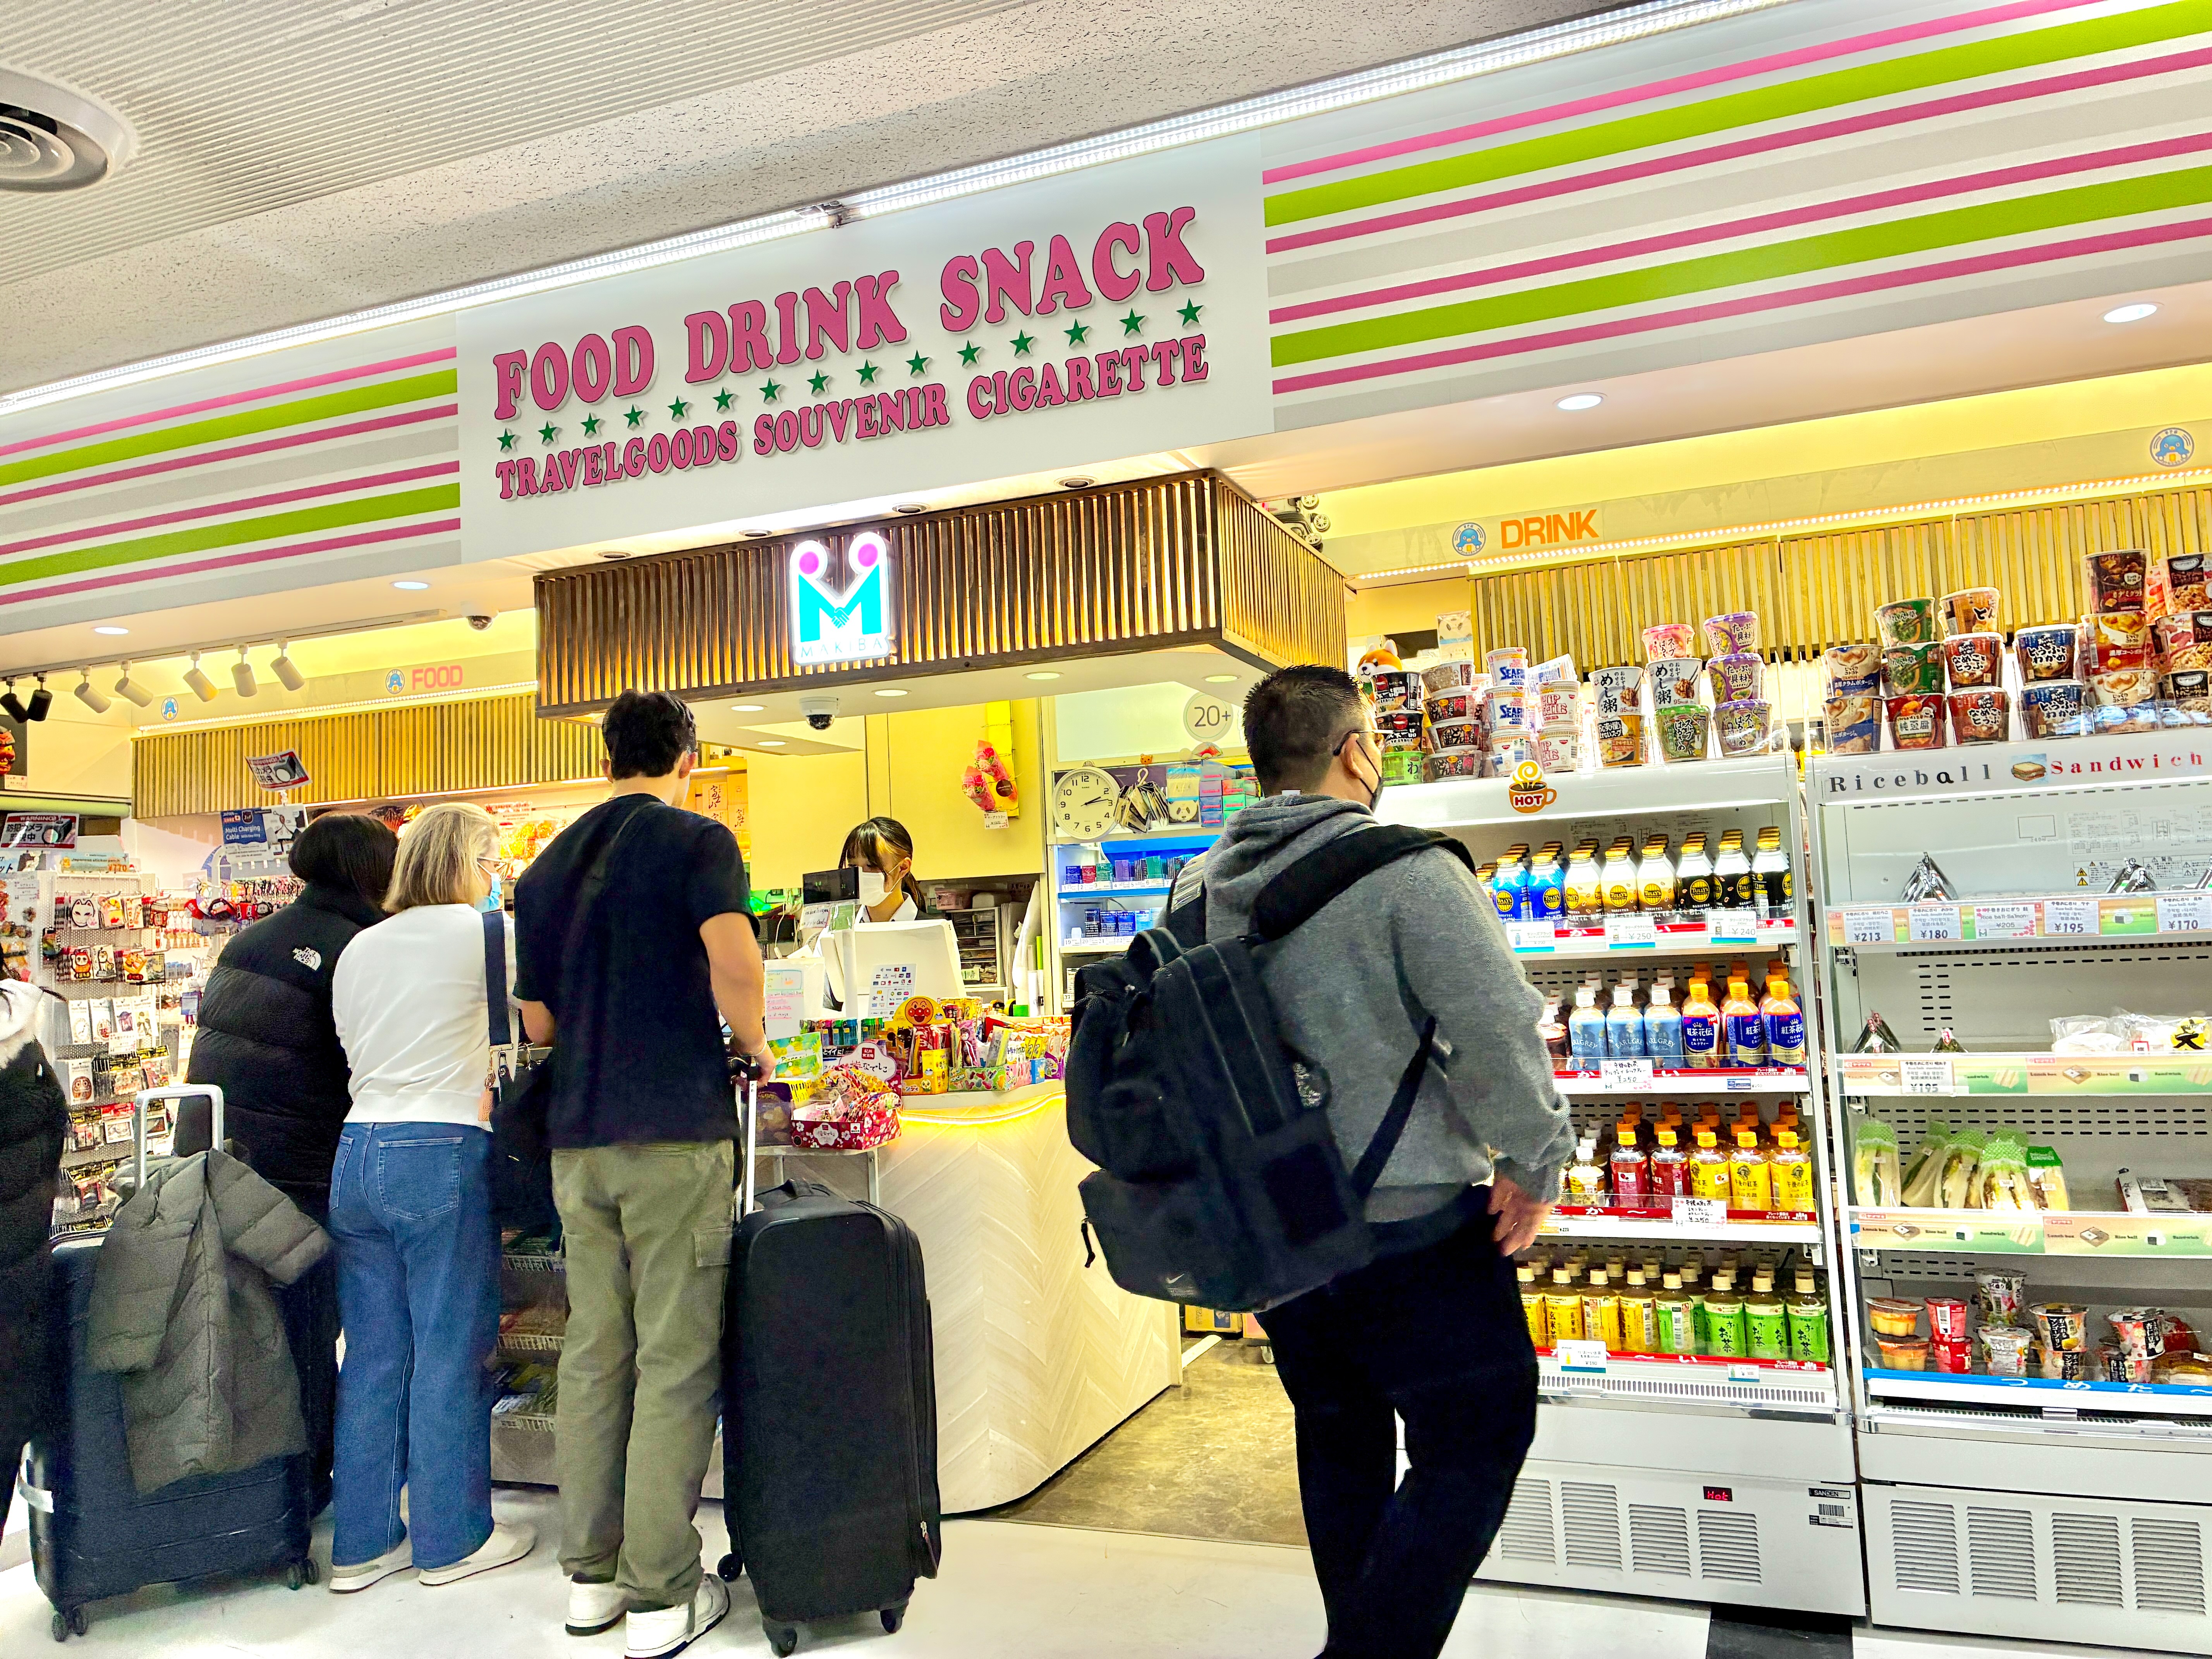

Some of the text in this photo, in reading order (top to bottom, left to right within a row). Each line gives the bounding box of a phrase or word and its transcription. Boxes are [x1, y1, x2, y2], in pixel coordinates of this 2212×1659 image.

[493, 206, 1205, 420] FOOD DRINK SNACK
[495, 334, 1209, 500] TRAVELGOODS SOUVENIR CIGARETTE
[1500, 509, 1600, 549] DRINK
[801, 638, 882, 658] MAKIBA
[2033, 655, 2066, 664] わかめ
[412, 665, 464, 690] FOOD
[1656, 664, 1671, 704] めし粥
[1601, 673, 1617, 713] めし粥
[1194, 705, 1231, 727] 20+
[1674, 721, 1685, 751] はるさめ
[1684, 719, 1694, 739] スープ
[1735, 715, 1746, 746] はるめ
[1829, 752, 2203, 793] Riceball Sandwich
[1513, 794, 1544, 809] HOT
[1921, 930, 1948, 939] ¥180
[2054, 922, 2084, 933] ¥195
[2168, 920, 2198, 929] ¥170
[1854, 933, 1881, 941] ¥213
[1686, 1027, 1714, 1036] 紅茶花伝
[1910, 1083, 1939, 1093] ¥195
[1707, 1490, 1729, 1501] Hot
